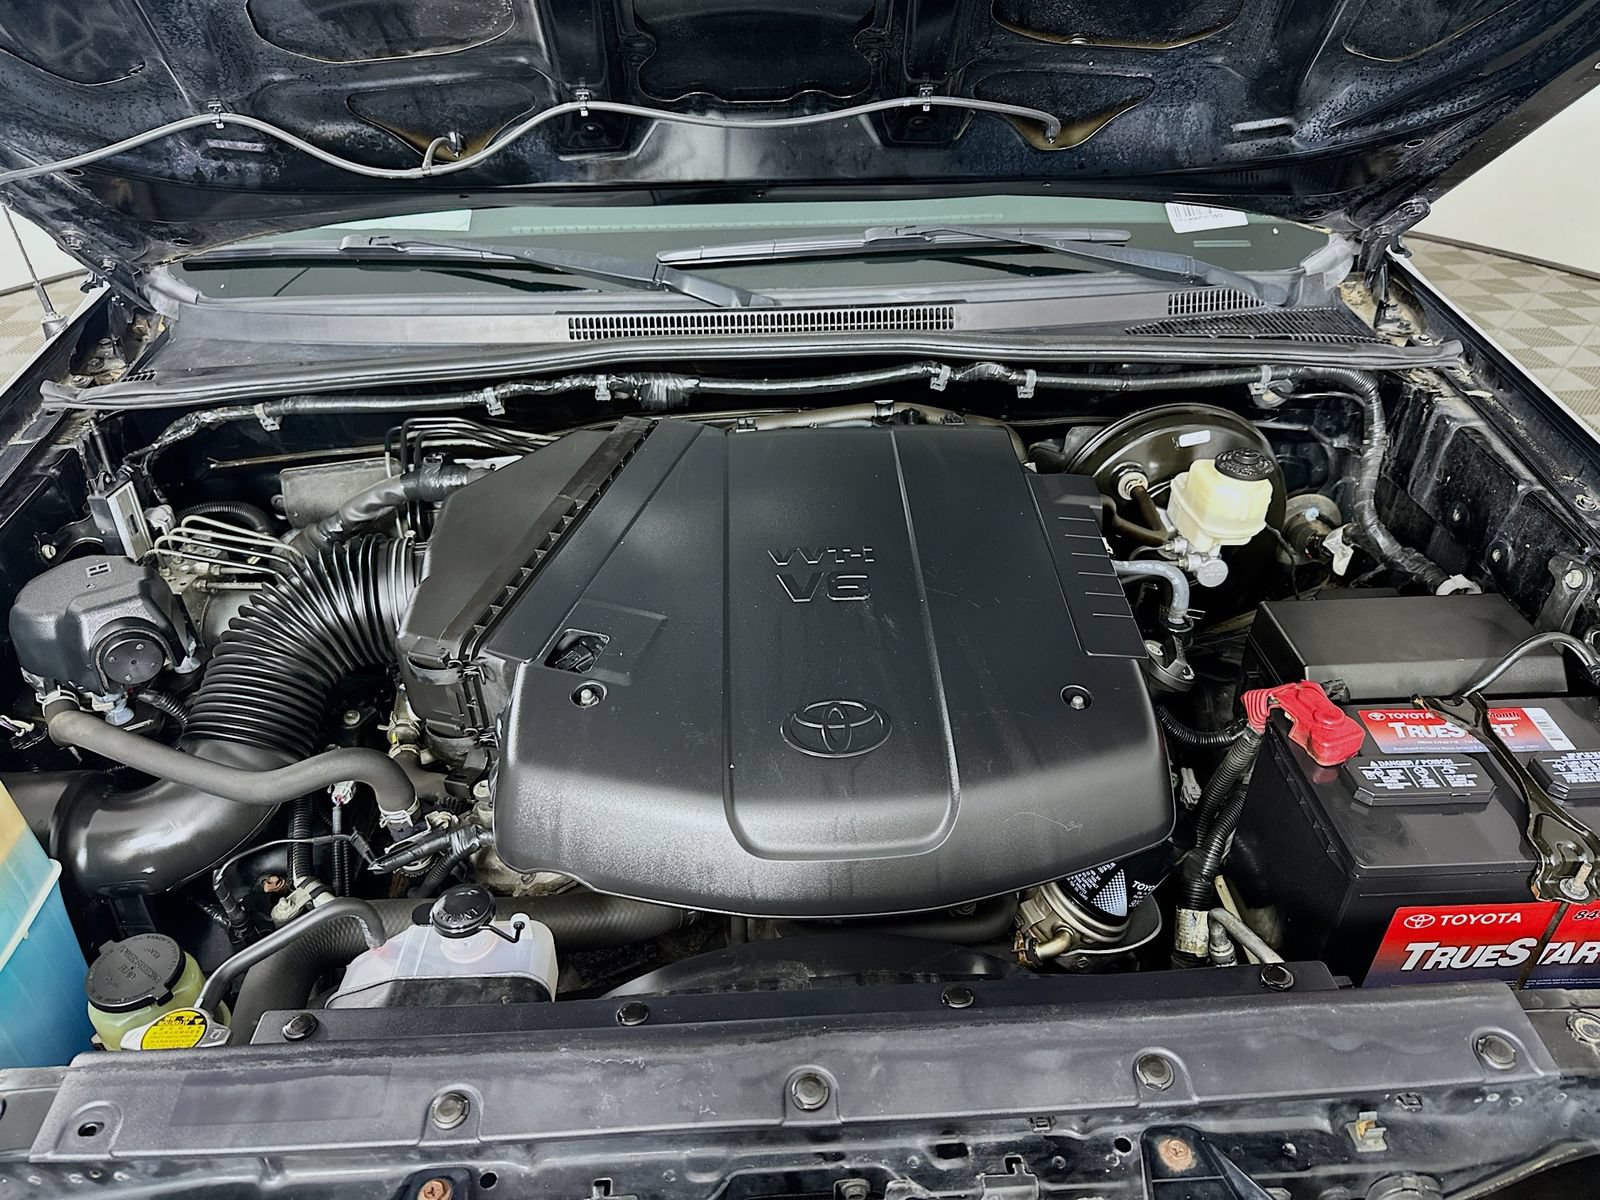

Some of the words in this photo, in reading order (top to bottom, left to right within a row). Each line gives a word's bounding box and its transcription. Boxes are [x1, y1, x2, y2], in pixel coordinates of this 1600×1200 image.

[776, 570, 871, 602] V6
[1386, 712, 1435, 720] TOYOTA
[1440, 912, 1522, 926] TOYOTA
